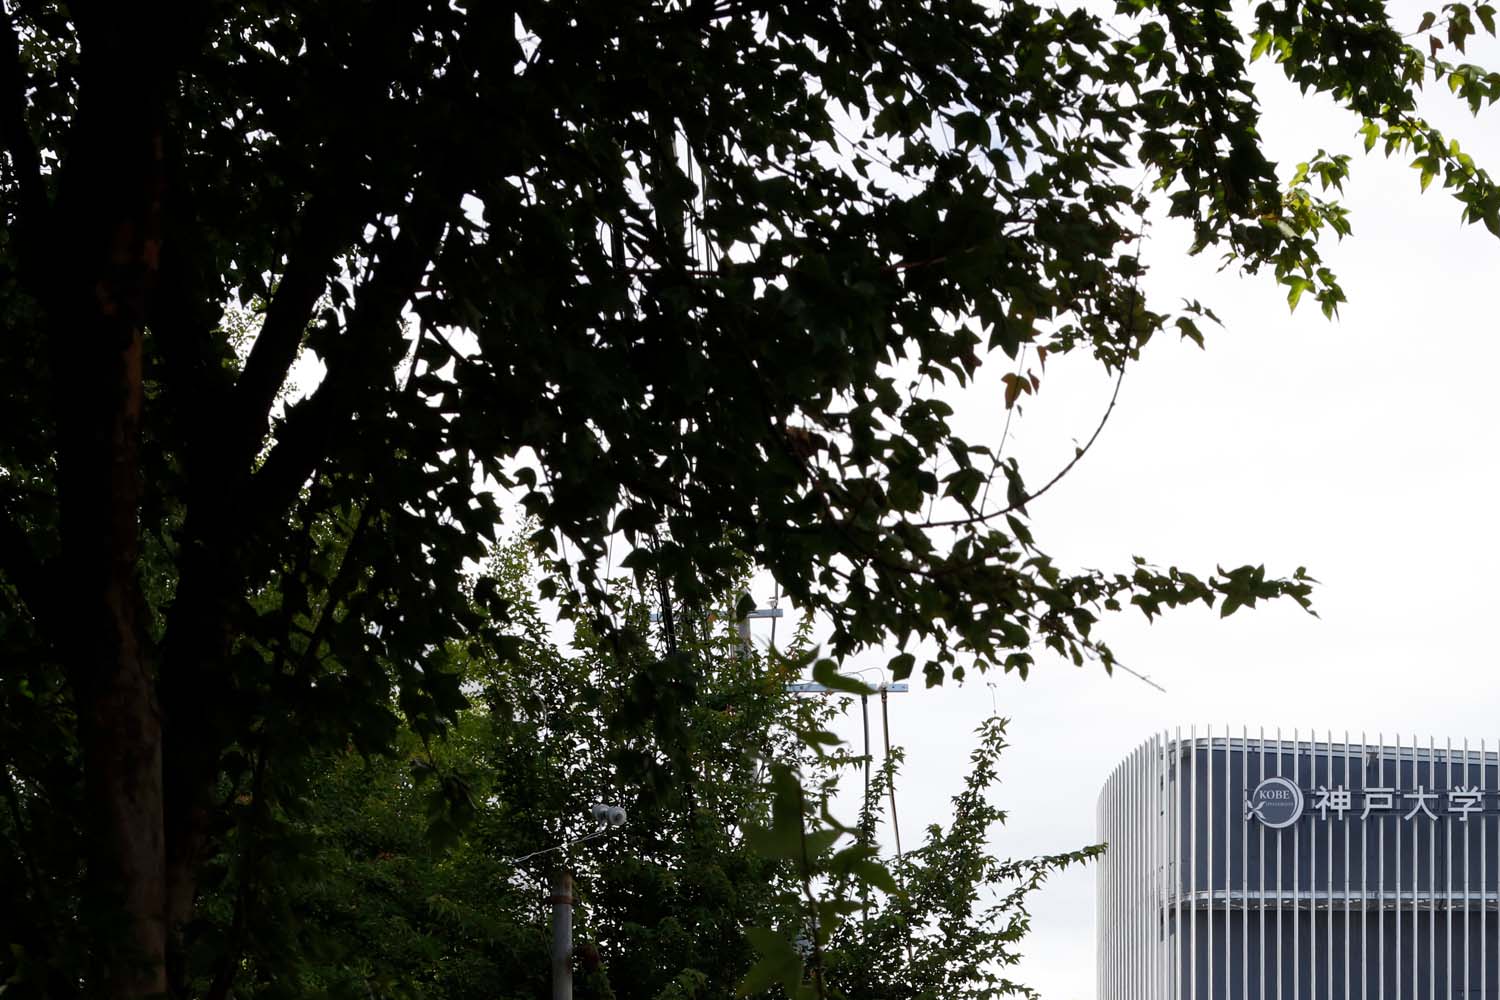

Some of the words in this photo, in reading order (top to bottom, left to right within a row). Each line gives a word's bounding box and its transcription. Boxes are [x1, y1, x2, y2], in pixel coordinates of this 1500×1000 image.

[1260, 790, 1290, 800] KOBE
[1315, 785, 1484, 821] 神戸大学
